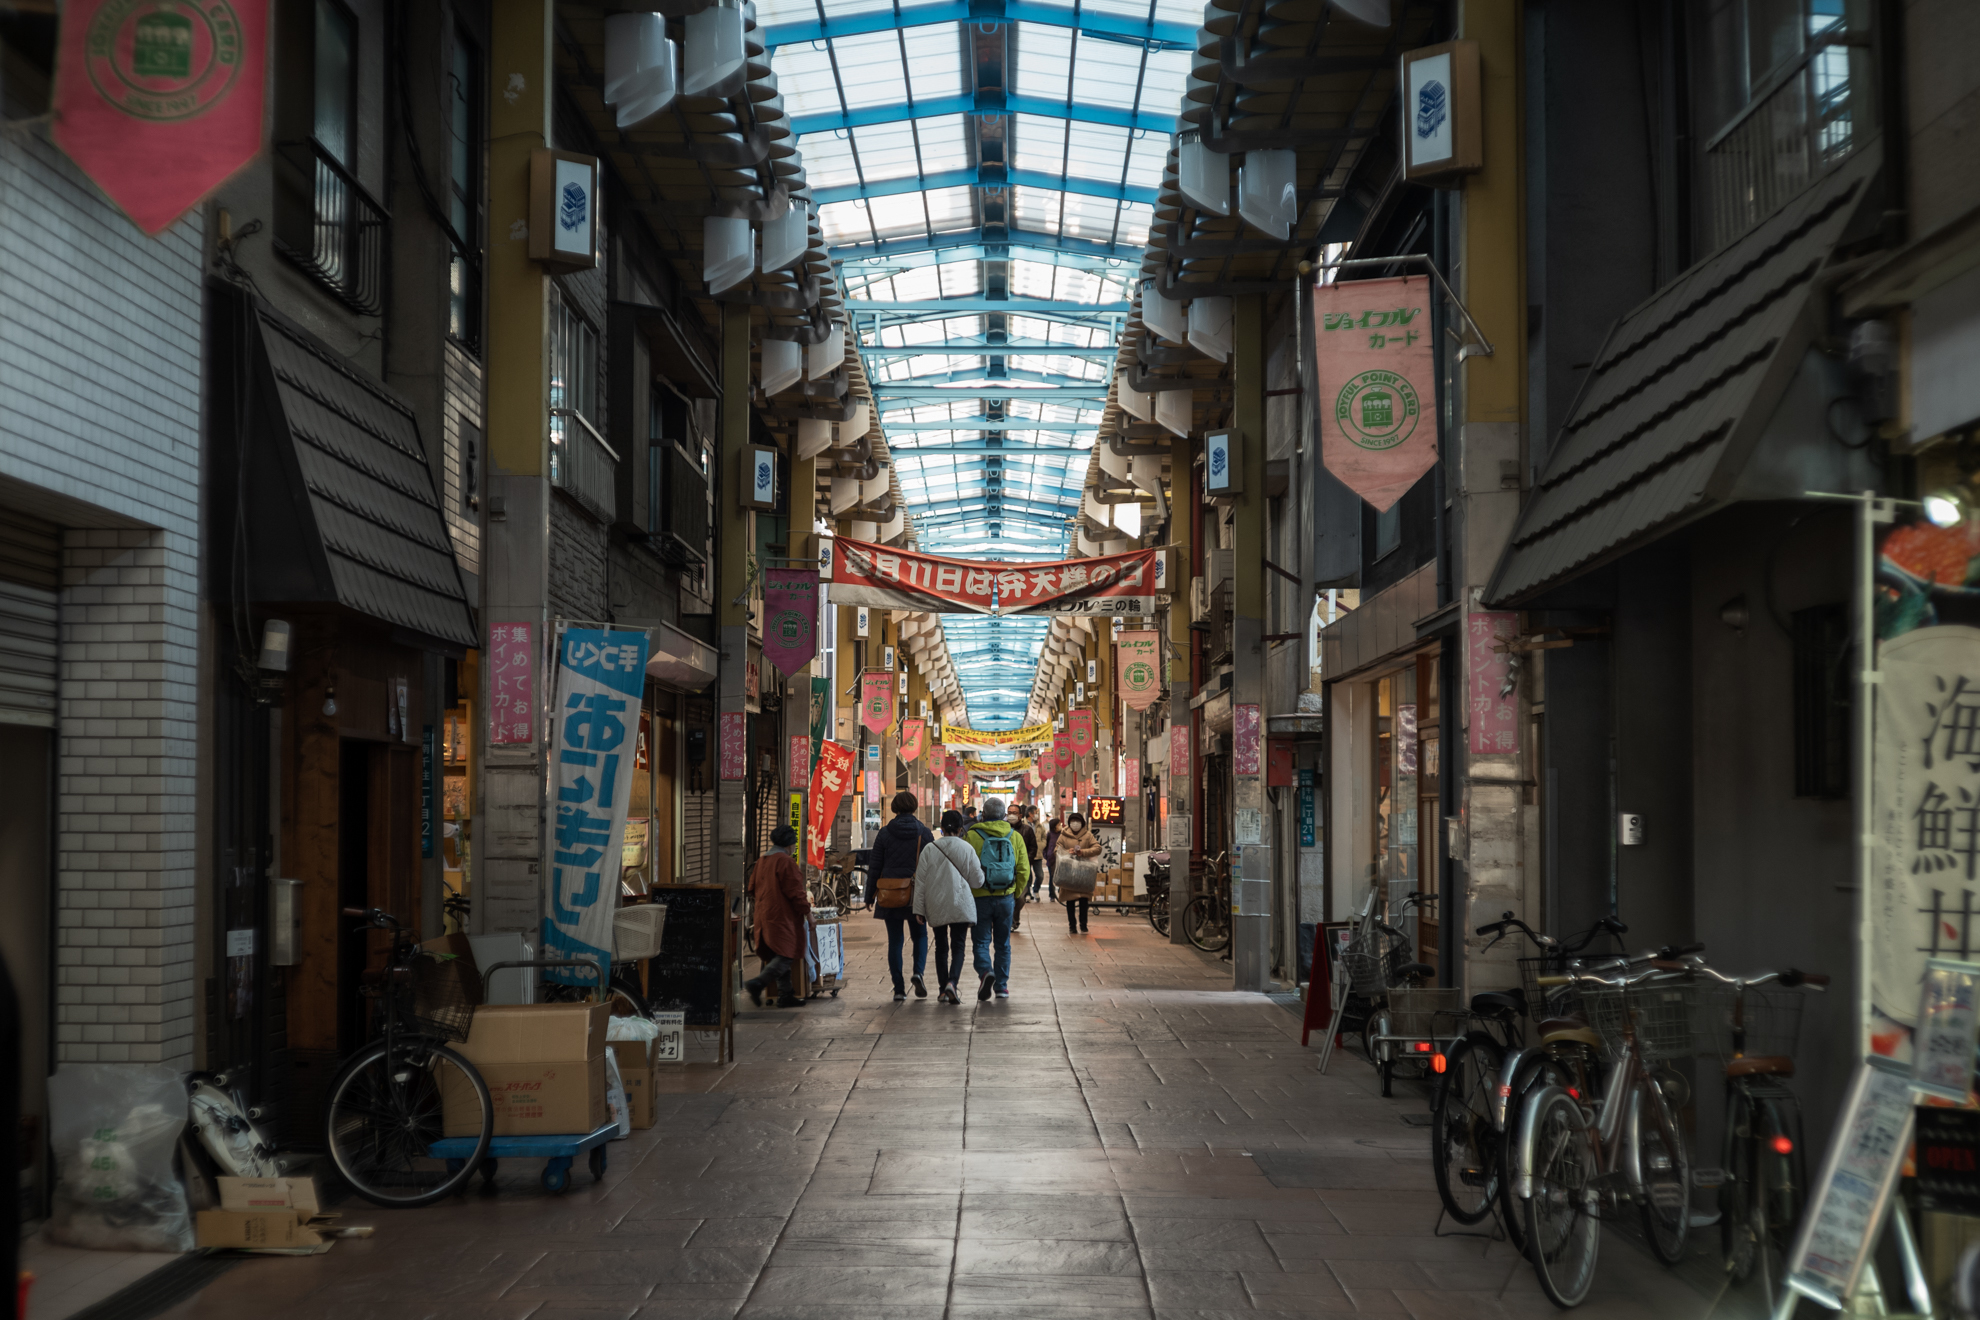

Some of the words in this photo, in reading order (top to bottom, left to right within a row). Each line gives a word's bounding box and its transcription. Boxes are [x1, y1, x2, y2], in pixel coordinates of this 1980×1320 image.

[1324, 308, 1421, 330] ジョイフル
[1370, 331, 1419, 349] カード
[1339, 383, 1360, 419] JOYFUL
[1362, 373, 1400, 385] POINT
[1401, 384, 1416, 416] CARD
[1361, 437, 1382, 447] SINCE
[1383, 434, 1400, 445] 1997
[768, 580, 814, 590] ジョイフル
[845, 547, 1143, 598] 毎月11日は弁天様の日
[491, 624, 510, 740] ポイントカード
[512, 625, 530, 739] 集めてお得
[1470, 617, 1492, 750] ポイントカード
[722, 713, 731, 778] ポイントカード
[733, 714, 742, 778] 集めてお得
[791, 737, 800, 786] ポイントカード
[799, 737, 808, 786] 集めてお得
[1172, 726, 1180, 774] ポイントカード
[1180, 727, 1188, 774] 集めてお得
[1091, 799, 1120, 810] TEL
[1302, 824, 1313, 834] 21
